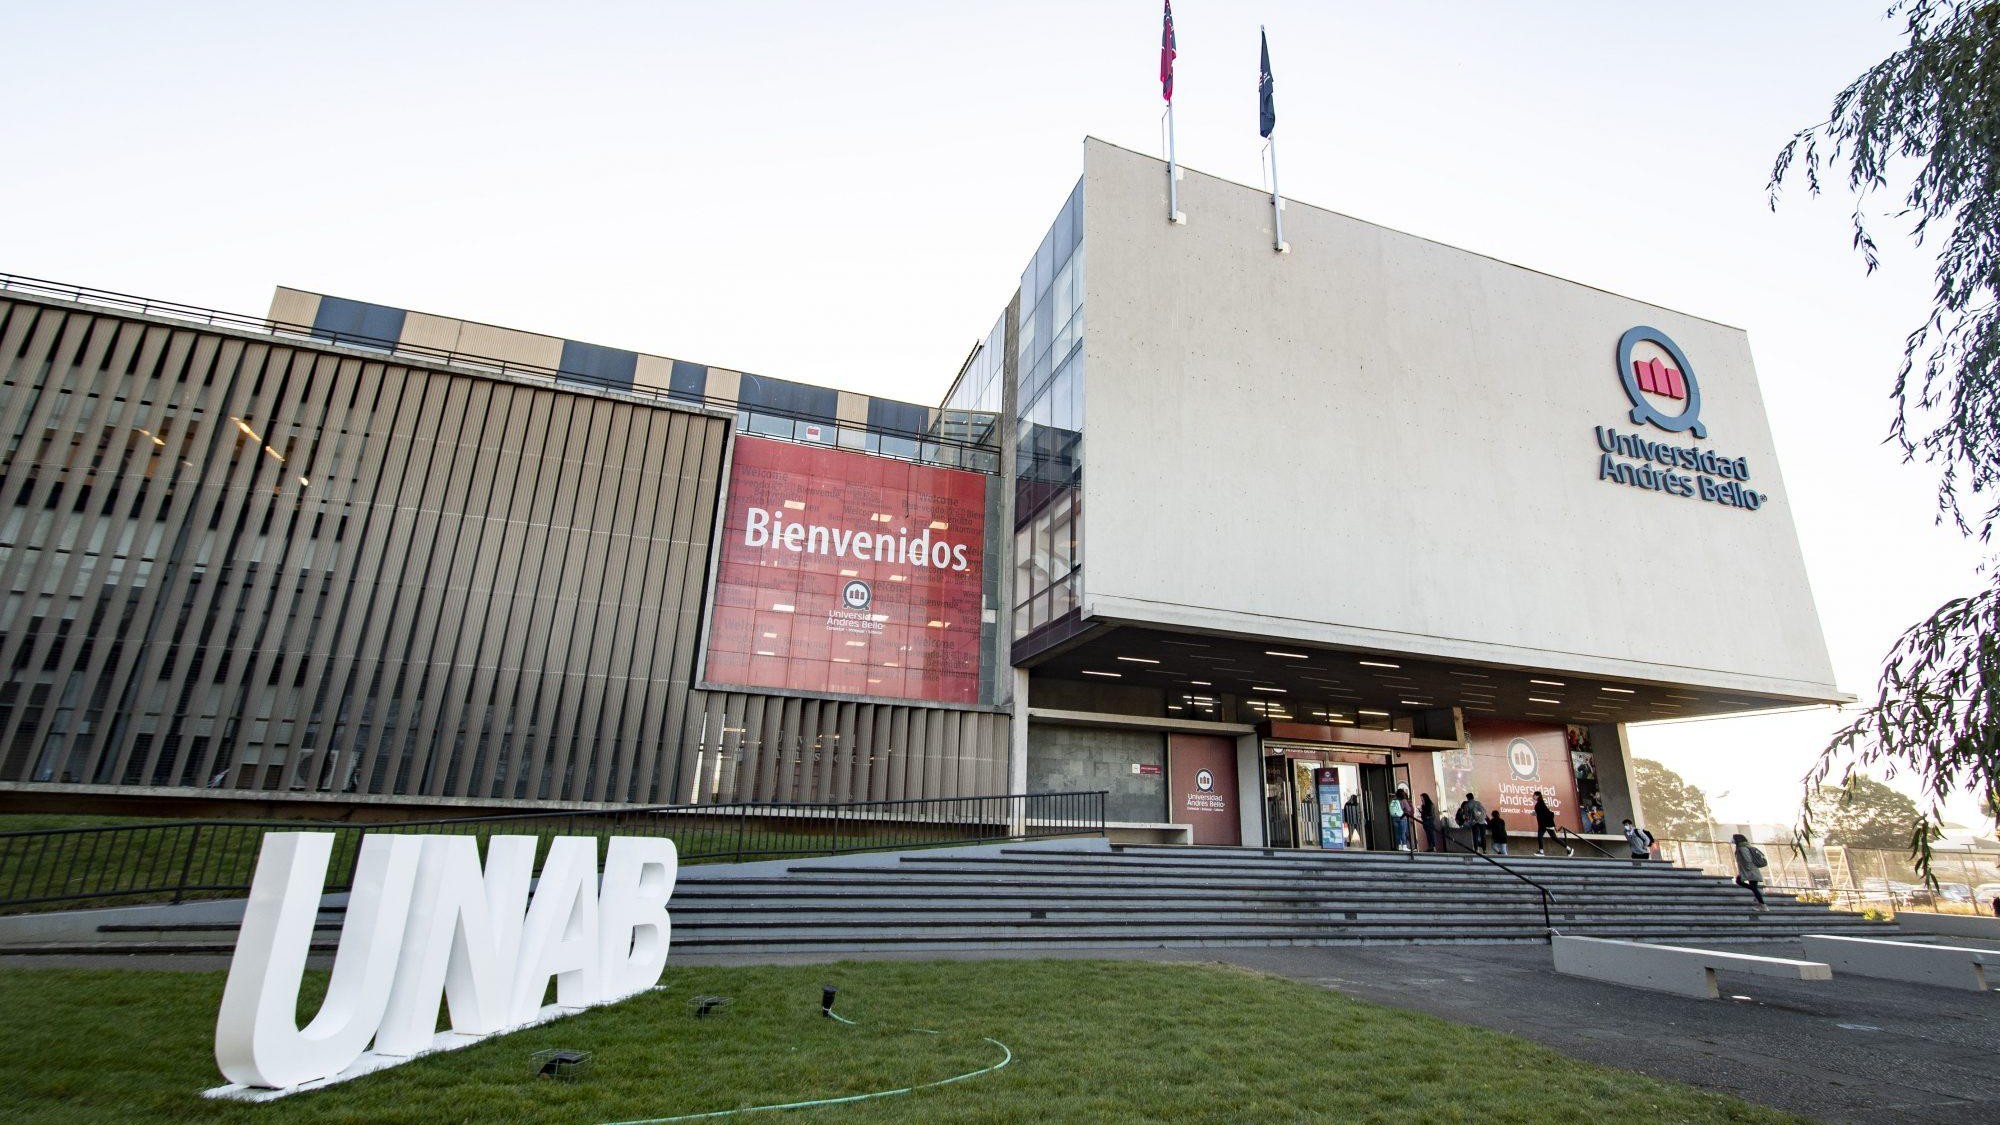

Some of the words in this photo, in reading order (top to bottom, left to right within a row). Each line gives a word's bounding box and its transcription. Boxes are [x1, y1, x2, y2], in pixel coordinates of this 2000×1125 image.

[1595, 425, 1750, 481] Universidad
[1599, 452, 1696, 497] Andrés
[744, 507, 968, 571] Bienvenidos
[1498, 783, 1556, 797] Universidad
[215, 831, 679, 1090] UNAB
